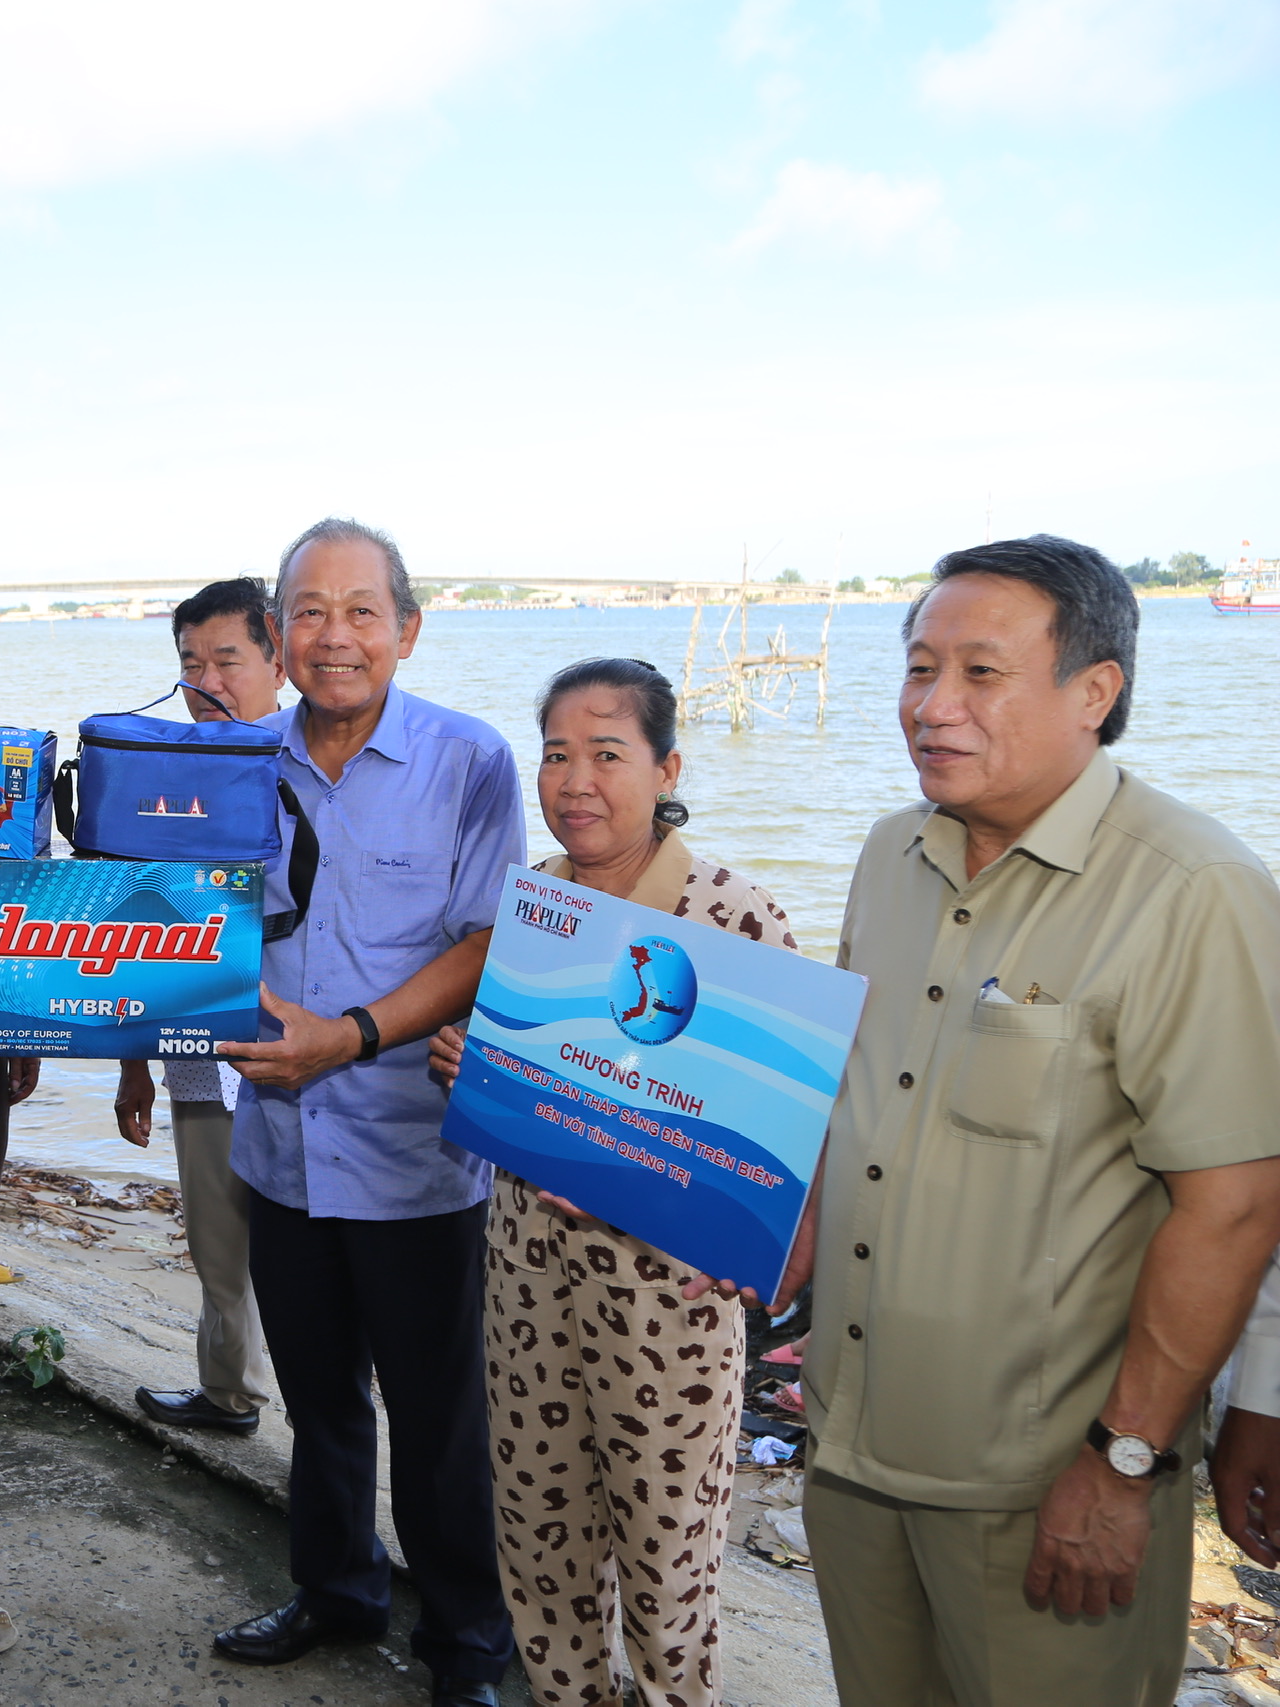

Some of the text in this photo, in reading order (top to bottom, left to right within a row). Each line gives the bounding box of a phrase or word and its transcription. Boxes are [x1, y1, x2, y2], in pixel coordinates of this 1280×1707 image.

[11, 768, 21, 777] AA
[515, 878, 593, 913] ĐƠN VỊ TỔ CHỨC
[49, 998, 145, 1022] HYBRID
[17, 1030, 31, 1038] OF
[33, 1031, 72, 1039] EUROPE
[160, 1028, 211, 1037] 12V 100Ah
[159, 1038, 210, 1055] N100
[559, 1042, 705, 1117] CHƯƠNG TRÌNH
[522, 1066, 553, 1088] NGƯ
[553, 1078, 580, 1102] DÂN
[620, 1107, 660, 1137] SÁNG
[662, 1121, 693, 1153] ĐÈN
[696, 1141, 736, 1172] TRÊN
[535, 1101, 693, 1189] ĐẾN VỚI TỈNH QUẢNG TRỊ
